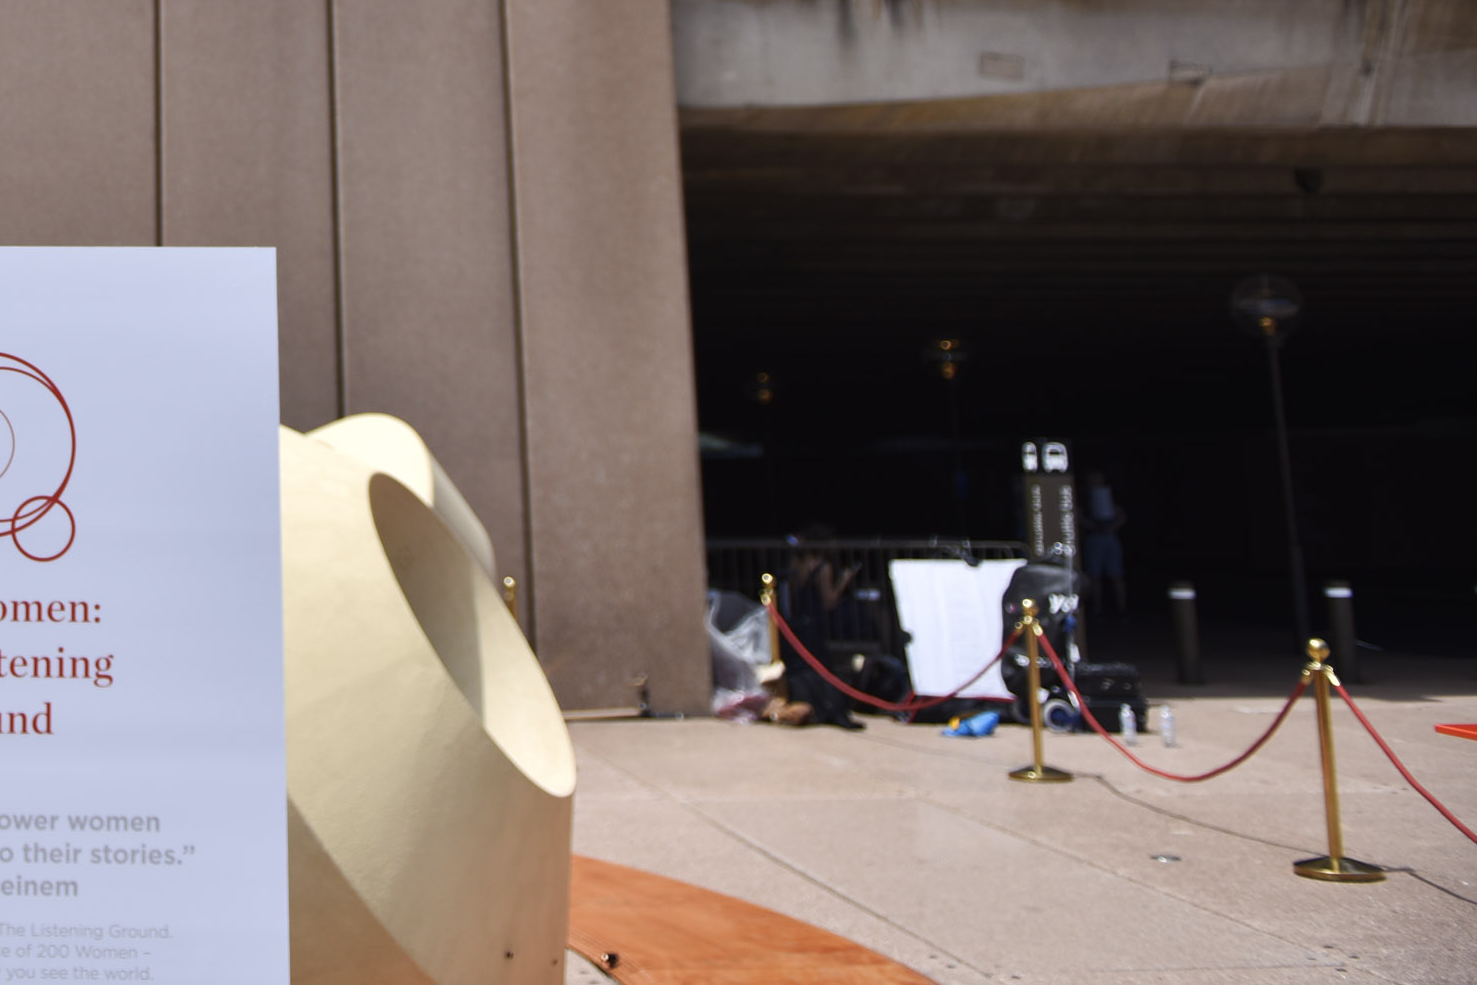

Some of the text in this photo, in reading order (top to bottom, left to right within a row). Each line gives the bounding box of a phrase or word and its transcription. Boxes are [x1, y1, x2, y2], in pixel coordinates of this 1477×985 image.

[67, 814, 161, 833] women
[22, 842, 83, 864] their
[30, 922, 104, 942] Listening
[108, 923, 173, 940] Ground.
[14, 943, 33, 959] of
[36, 943, 71, 959] 200
[74, 944, 139, 960] Women
[5, 966, 37, 982] you
[40, 967, 69, 981] see
[72, 965, 100, 981] the
[103, 966, 154, 982] world.
